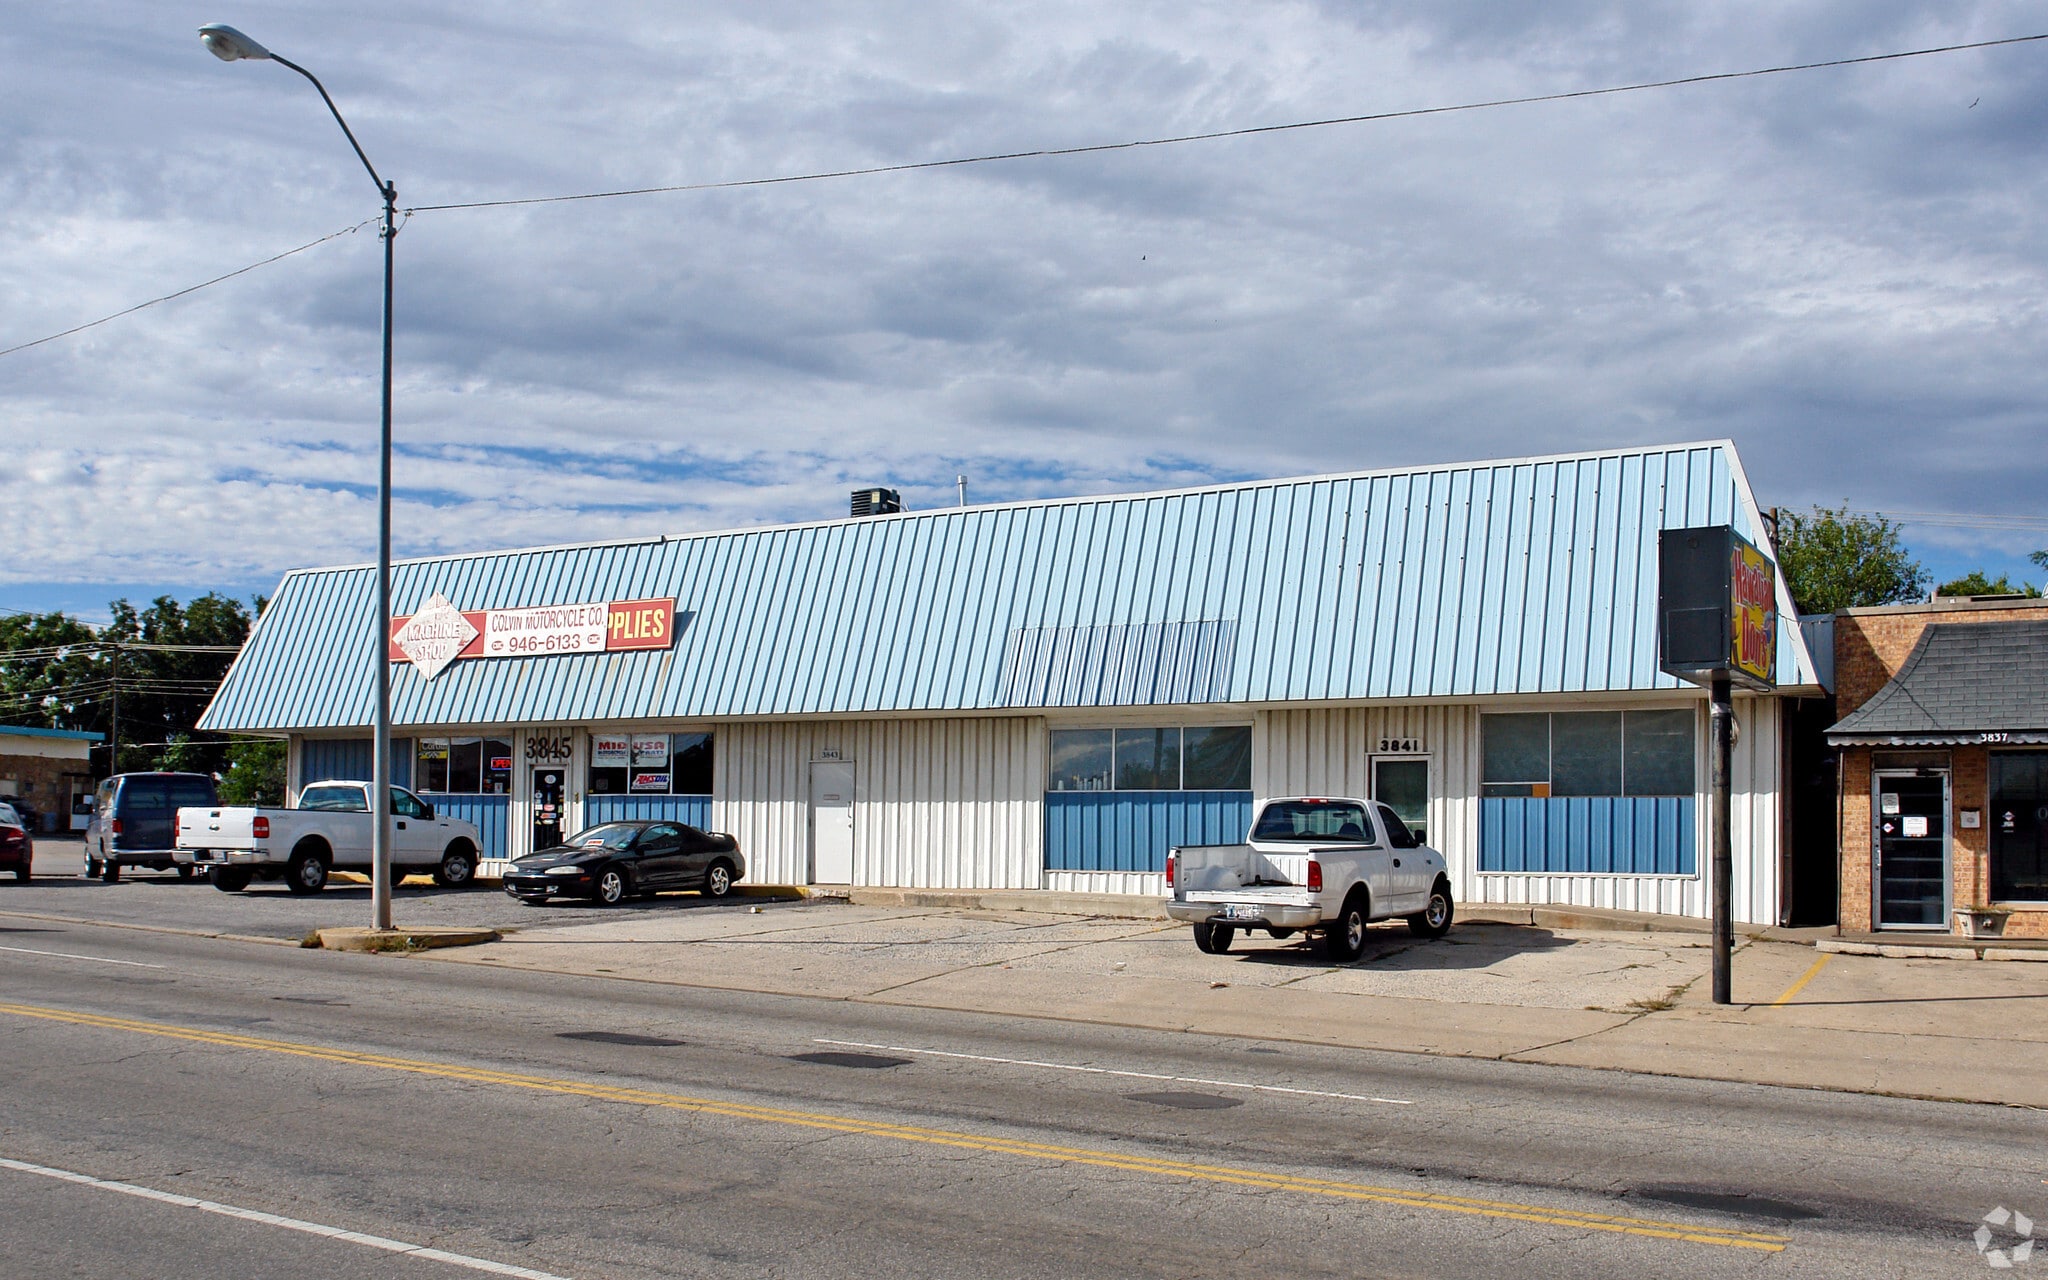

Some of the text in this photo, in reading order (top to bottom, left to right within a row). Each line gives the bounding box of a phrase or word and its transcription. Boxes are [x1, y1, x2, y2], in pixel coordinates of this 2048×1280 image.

[491, 607, 604, 632] COLVIN MOTORCYCLE CO.
[406, 621, 460, 642] MACHINE
[509, 634, 581, 652] 946-6133
[415, 642, 448, 662] SHOP
[598, 741, 665, 750] MID USA
[1980, 733, 2008, 743] 3837
[526, 736, 572, 759] 3845
[1380, 740, 1418, 752] 3841
[821, 751, 838, 759] 3843
[635, 774, 669, 785] AMSOIL
